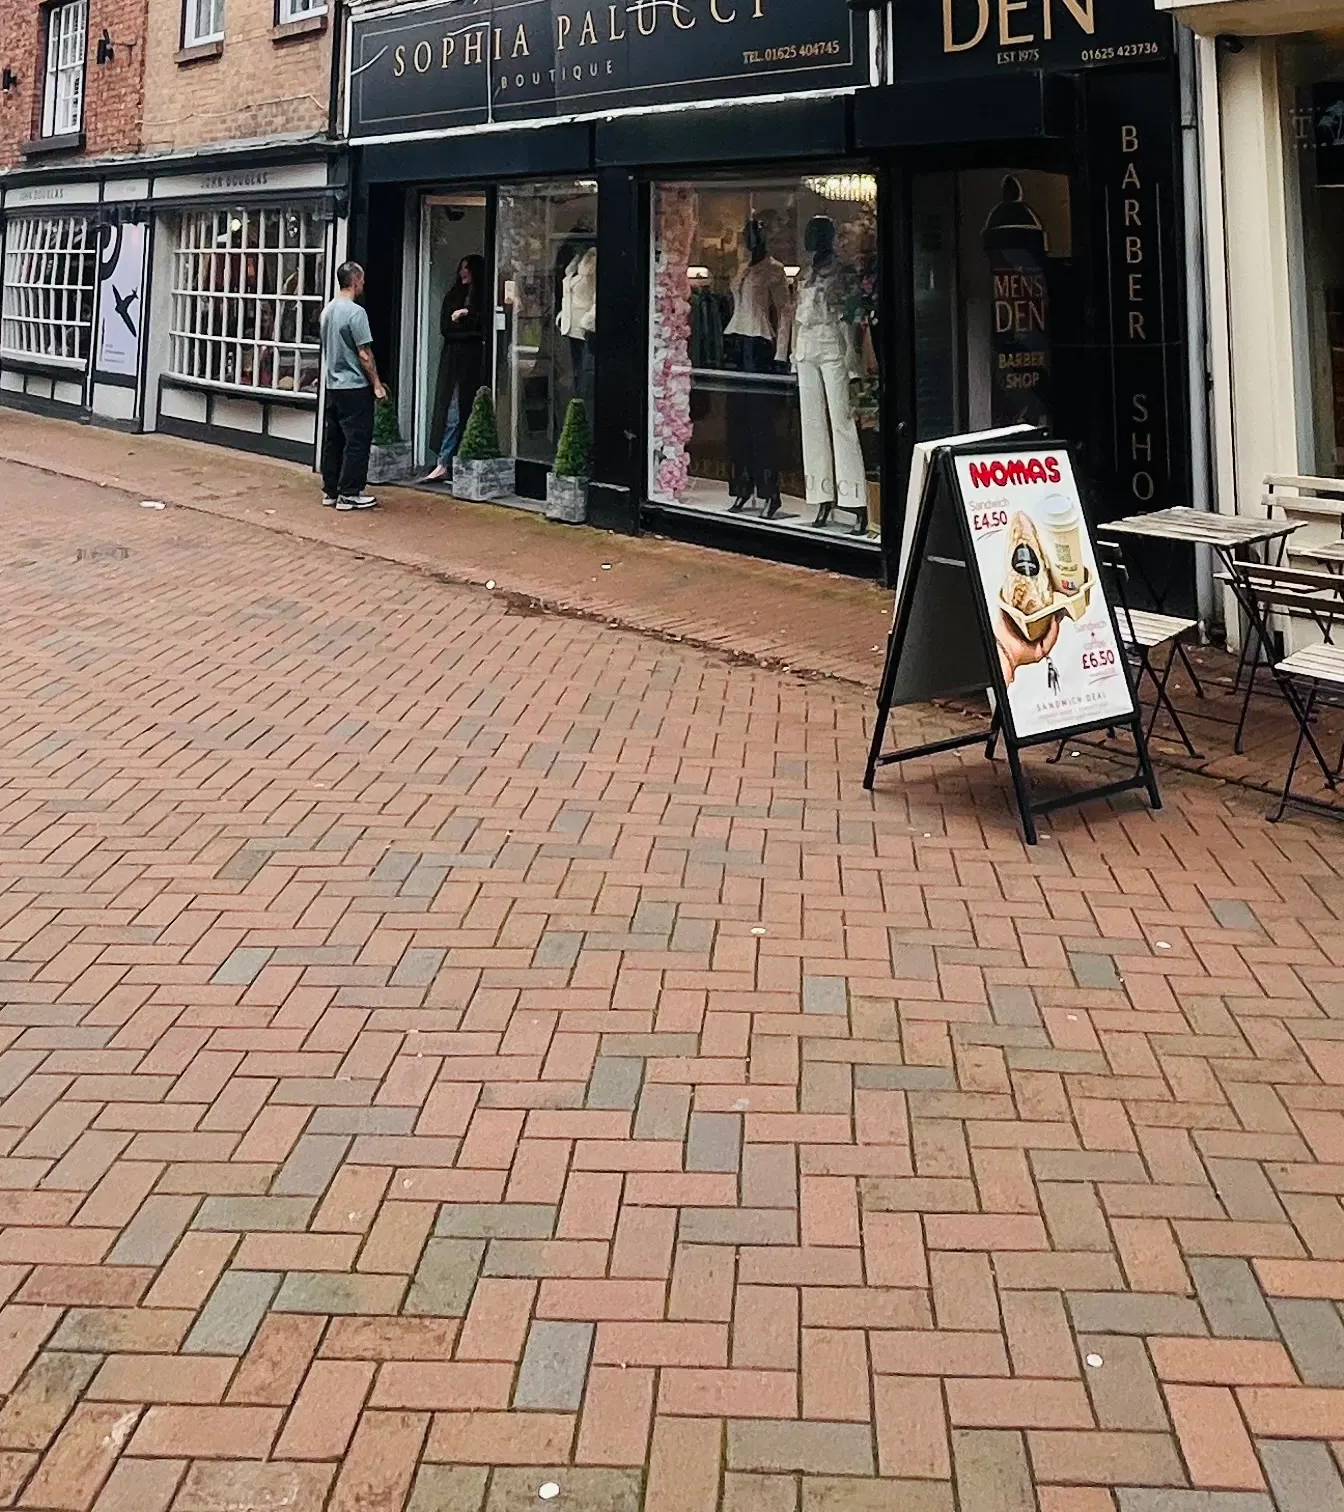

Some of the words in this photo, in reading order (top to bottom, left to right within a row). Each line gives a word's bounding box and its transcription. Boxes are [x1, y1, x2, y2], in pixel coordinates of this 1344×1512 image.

[393, 23, 530, 78] SOPHIA
[764, 44, 797, 61] 01625
[798, 40, 840, 58] 404745
[997, 52, 1017, 65] EST
[1019, 49, 1040, 63] 1975
[1081, 48, 1114, 61] 01625
[1117, 42, 1158, 58] 423736
[501, 59, 614, 89] BOUTIQUE
[1120, 125, 1147, 341] BARBER
[993, 274, 1045, 299] MENS
[995, 300, 1045, 333] DEN
[1006, 372, 1040, 389] SHOP
[1131, 393, 1155, 516] SHO
[969, 456, 1061, 488] NOMAS
[973, 510, 1008, 531] £4.50
[1082, 649, 1115, 670] £6.50
[1036, 697, 1082, 712] SANDWICH
[1086, 691, 1106, 703] DEAL
